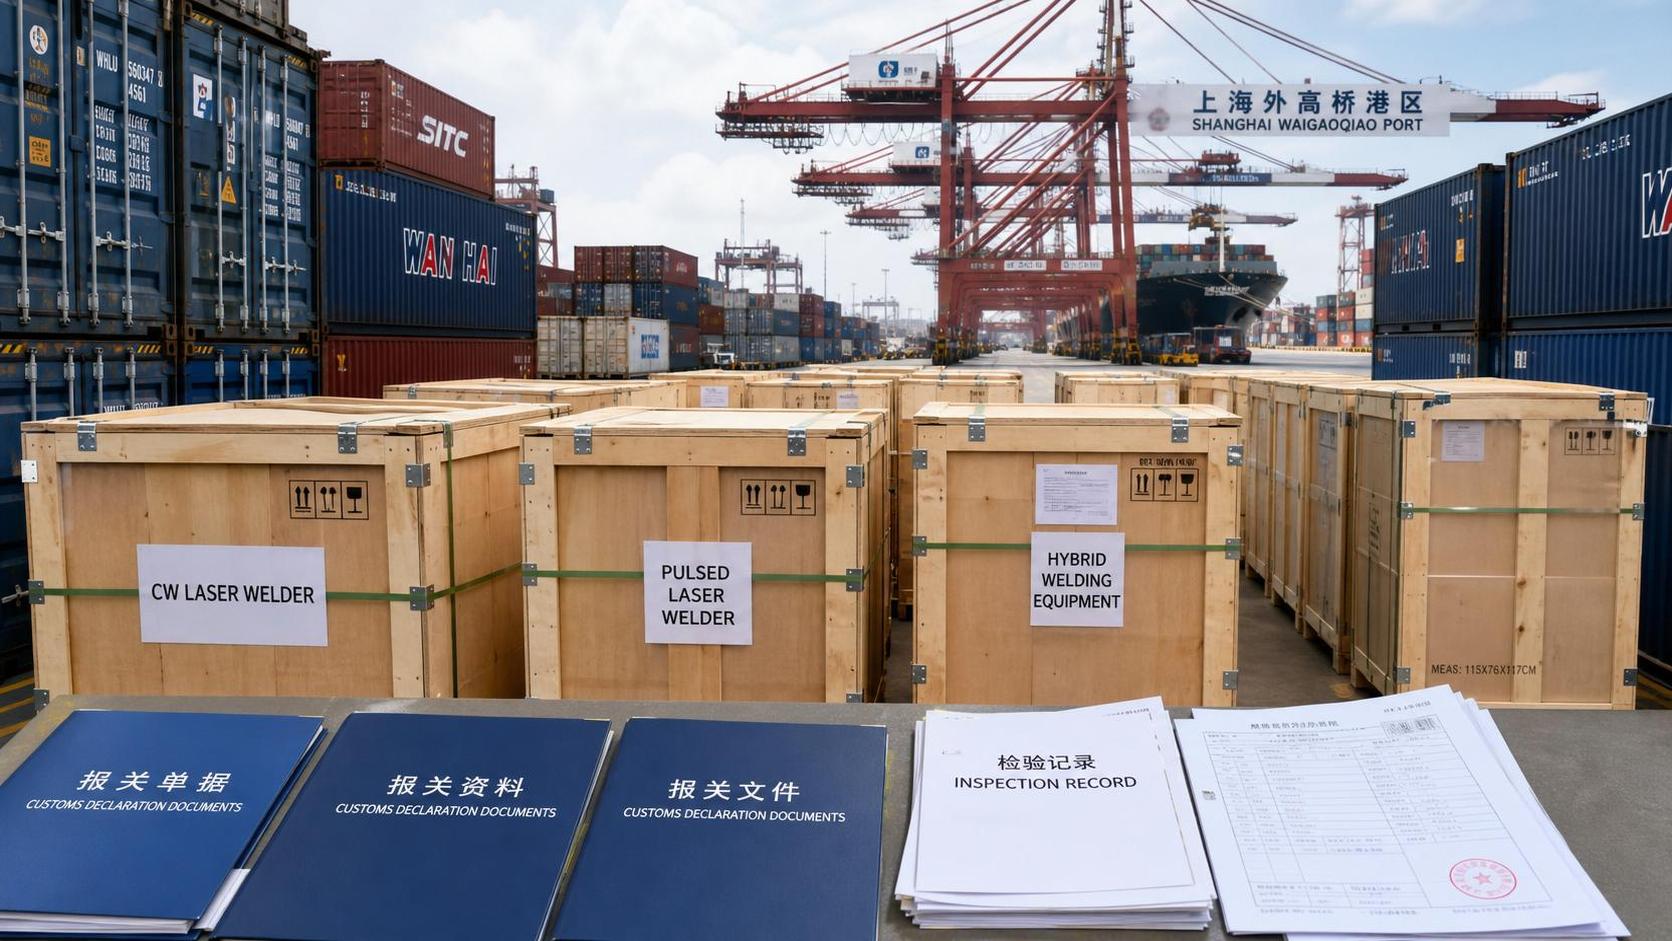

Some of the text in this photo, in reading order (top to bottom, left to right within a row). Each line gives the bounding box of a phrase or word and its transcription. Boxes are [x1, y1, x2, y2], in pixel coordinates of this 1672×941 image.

[96, 49, 118, 72] WHLU
[1193, 89, 1423, 115] 上海外高桥港区
[1192, 118, 1424, 132] SHANGHAI WAIGAOQIAO PORT
[417, 114, 469, 158] SITC
[403, 227, 498, 286] WAN HAI
[1047, 552, 1107, 567] HYBRID
[661, 565, 730, 581] PULSED
[1041, 573, 1112, 588] WELDING
[151, 583, 315, 604] CW LASER WELDER
[669, 587, 725, 603] LASER
[1033, 594, 1121, 610] EQUIPMENT
[661, 610, 736, 626] WELDER
[1431, 664, 1462, 675] MEAS:
[997, 754, 1096, 771] 检验记录
[76, 769, 231, 793] 报关单据
[386, 774, 525, 798] 报关资料
[954, 776, 1137, 790] INSPECTION RECORD
[668, 778, 800, 803] 报关文件
[25, 799, 243, 813] CUSTOMS DECLARATION DOCUMENTS
[335, 803, 557, 818] CUSTOMS DECLARATION DOCUMENTS
[623, 807, 846, 823] CUSTOMS DECLARATION DOCUMENTS
